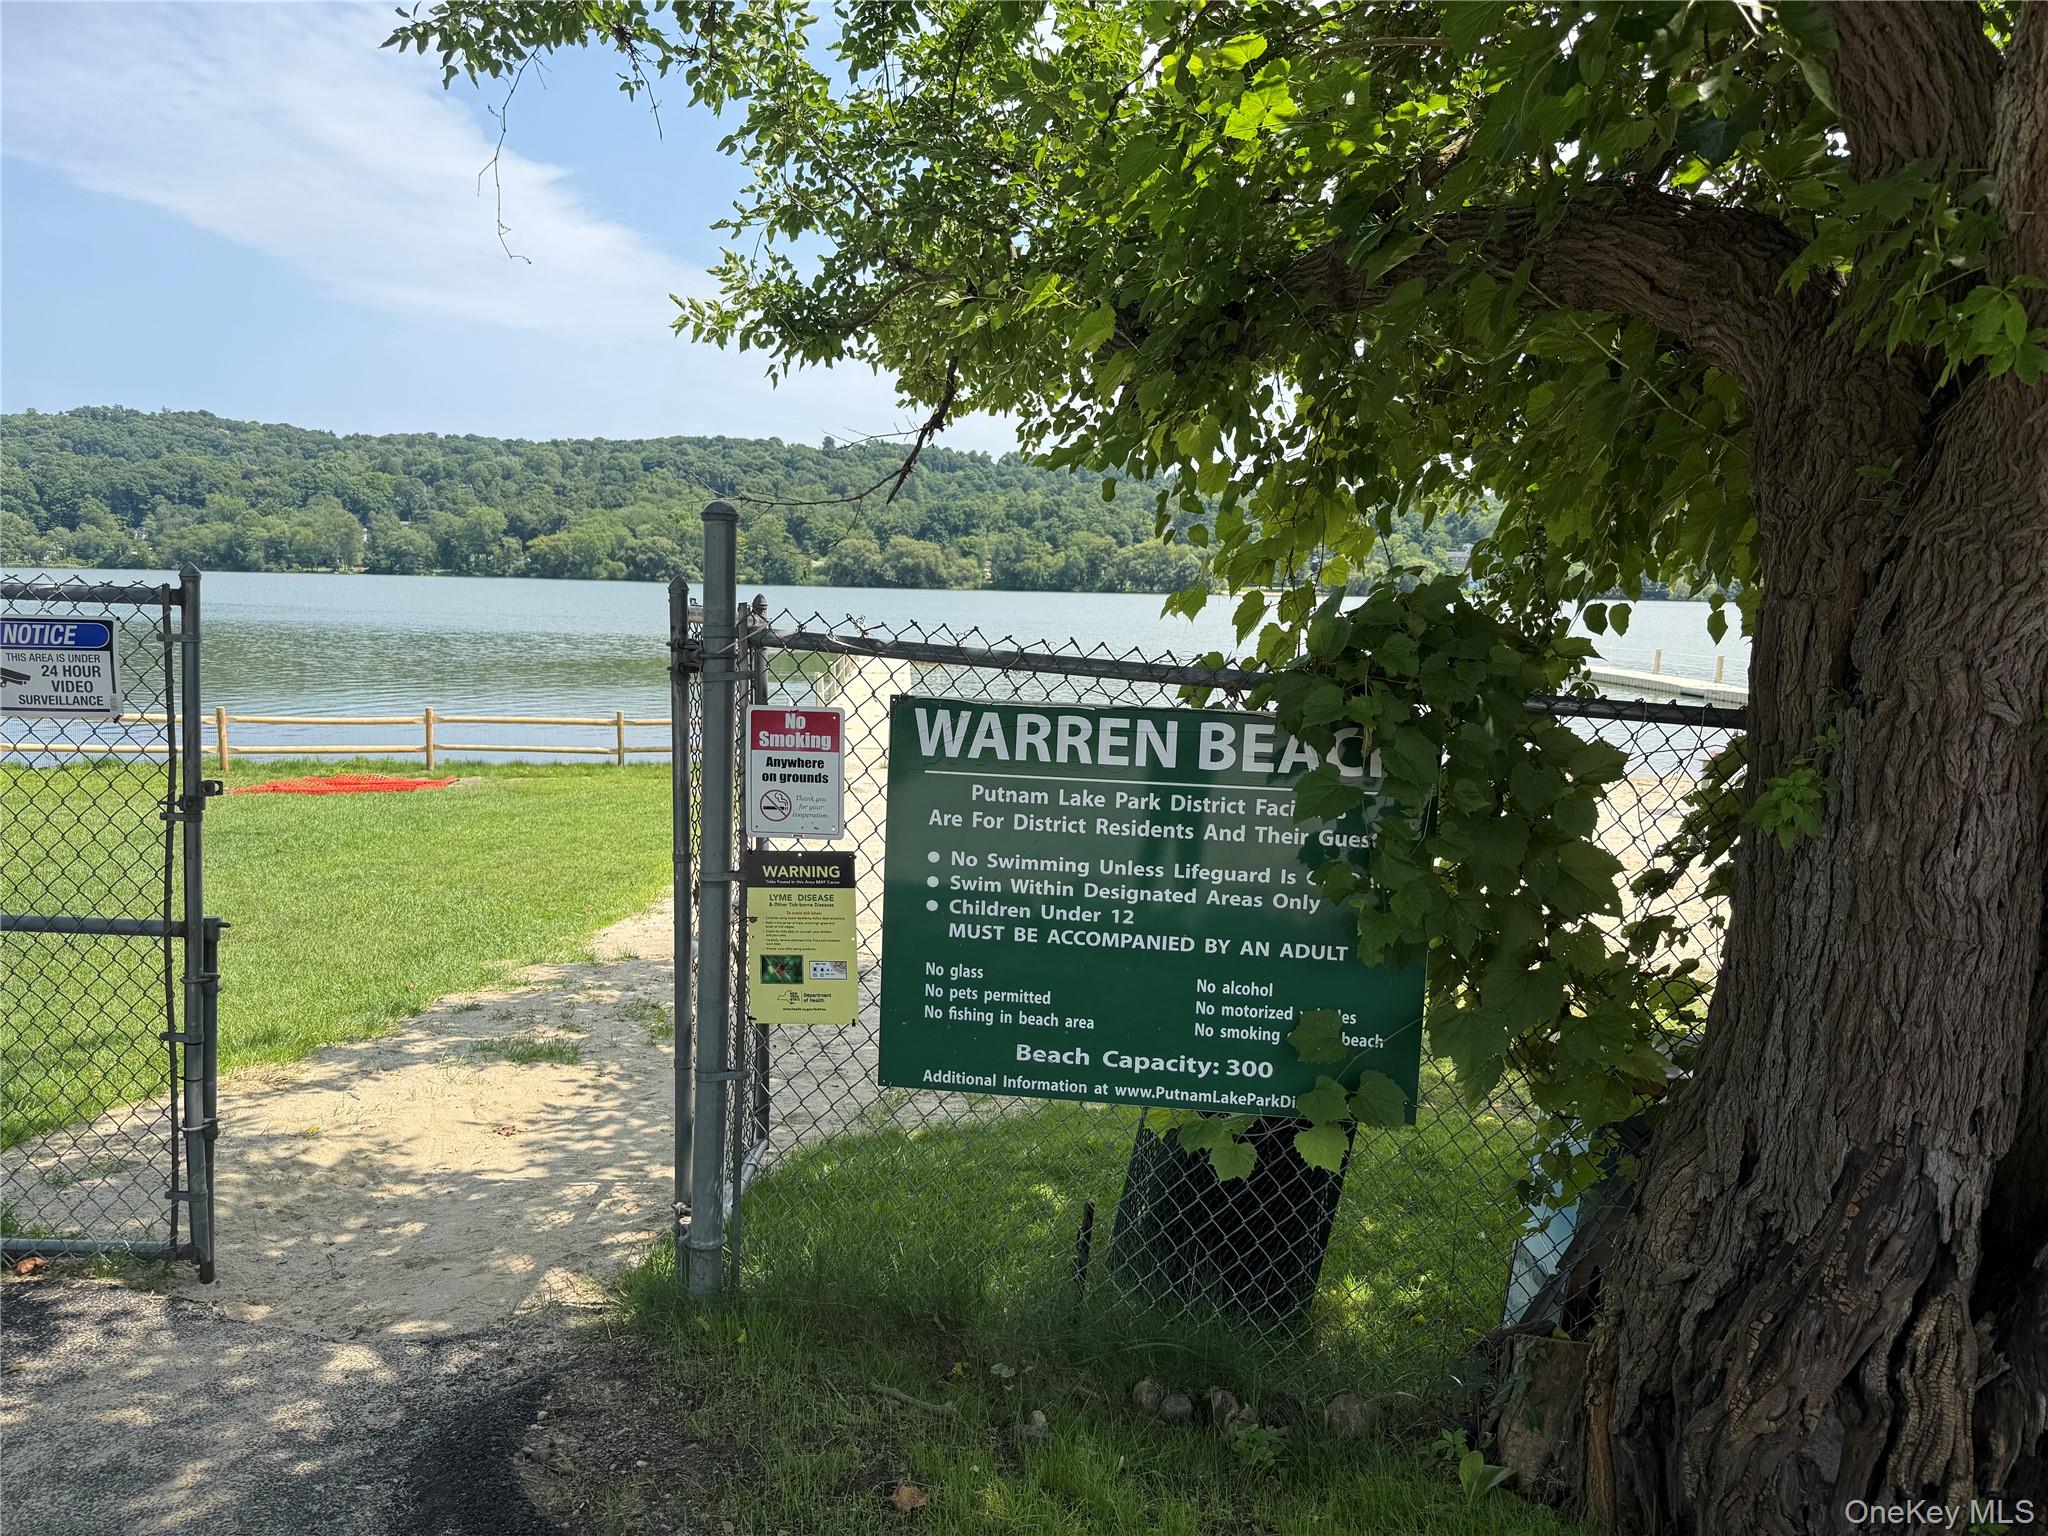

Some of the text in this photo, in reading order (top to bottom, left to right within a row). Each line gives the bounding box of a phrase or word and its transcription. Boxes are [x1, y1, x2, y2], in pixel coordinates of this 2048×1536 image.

[3, 624, 77, 645] NOTICE
[6, 653, 101, 663] THIS AREA IS UNDER
[41, 665, 101, 678] 24 HOUR
[51, 680, 93, 693] VIDEO
[18, 695, 104, 706] SURVEILLANCE
[785, 713, 806, 729] No
[759, 730, 831, 751] Smoking
[915, 707, 1178, 768] WARREN
[766, 757, 824, 769] Anywhere
[762, 772, 829, 784] on grounds
[972, 785, 1048, 804] Putnam
[1059, 789, 1105, 807] Lake
[1116, 792, 1160, 810] Park
[1171, 795, 1246, 814] District
[929, 809, 1377, 848] Are For District Residents And Their Guest
[762, 865, 840, 878] WARNING
[952, 851, 977, 866] No
[988, 853, 1089, 877] Swimming
[1100, 859, 1164, 877] Unless
[1175, 864, 1270, 884] Lifeguard
[1281, 869, 1296, 884] Is
[798, 894, 834, 902] DISEASE
[951, 875, 1320, 914] Swim Within Designated Areas Only
[950, 899, 1133, 924] Children Under 12
[949, 923, 1348, 961] MUST BE ACCOMPANIED BY AN ADULT
[926, 962, 983, 980] No glass
[926, 984, 1050, 1004] No pets permitted
[1197, 979, 1272, 996] No alcohol
[925, 1005, 1094, 1029] No fishing in beach area
[1196, 1001, 1214, 1015] No
[1222, 1005, 1293, 1020] motorized
[1195, 1023, 1214, 1037] No
[1220, 1026, 1280, 1045] smoking
[1342, 1032, 1383, 1048] beach
[1017, 1044, 1273, 1078] Beach Capacity: 300
[923, 1070, 1297, 1109] Additional Information at www.PutnamLakeParkDi
